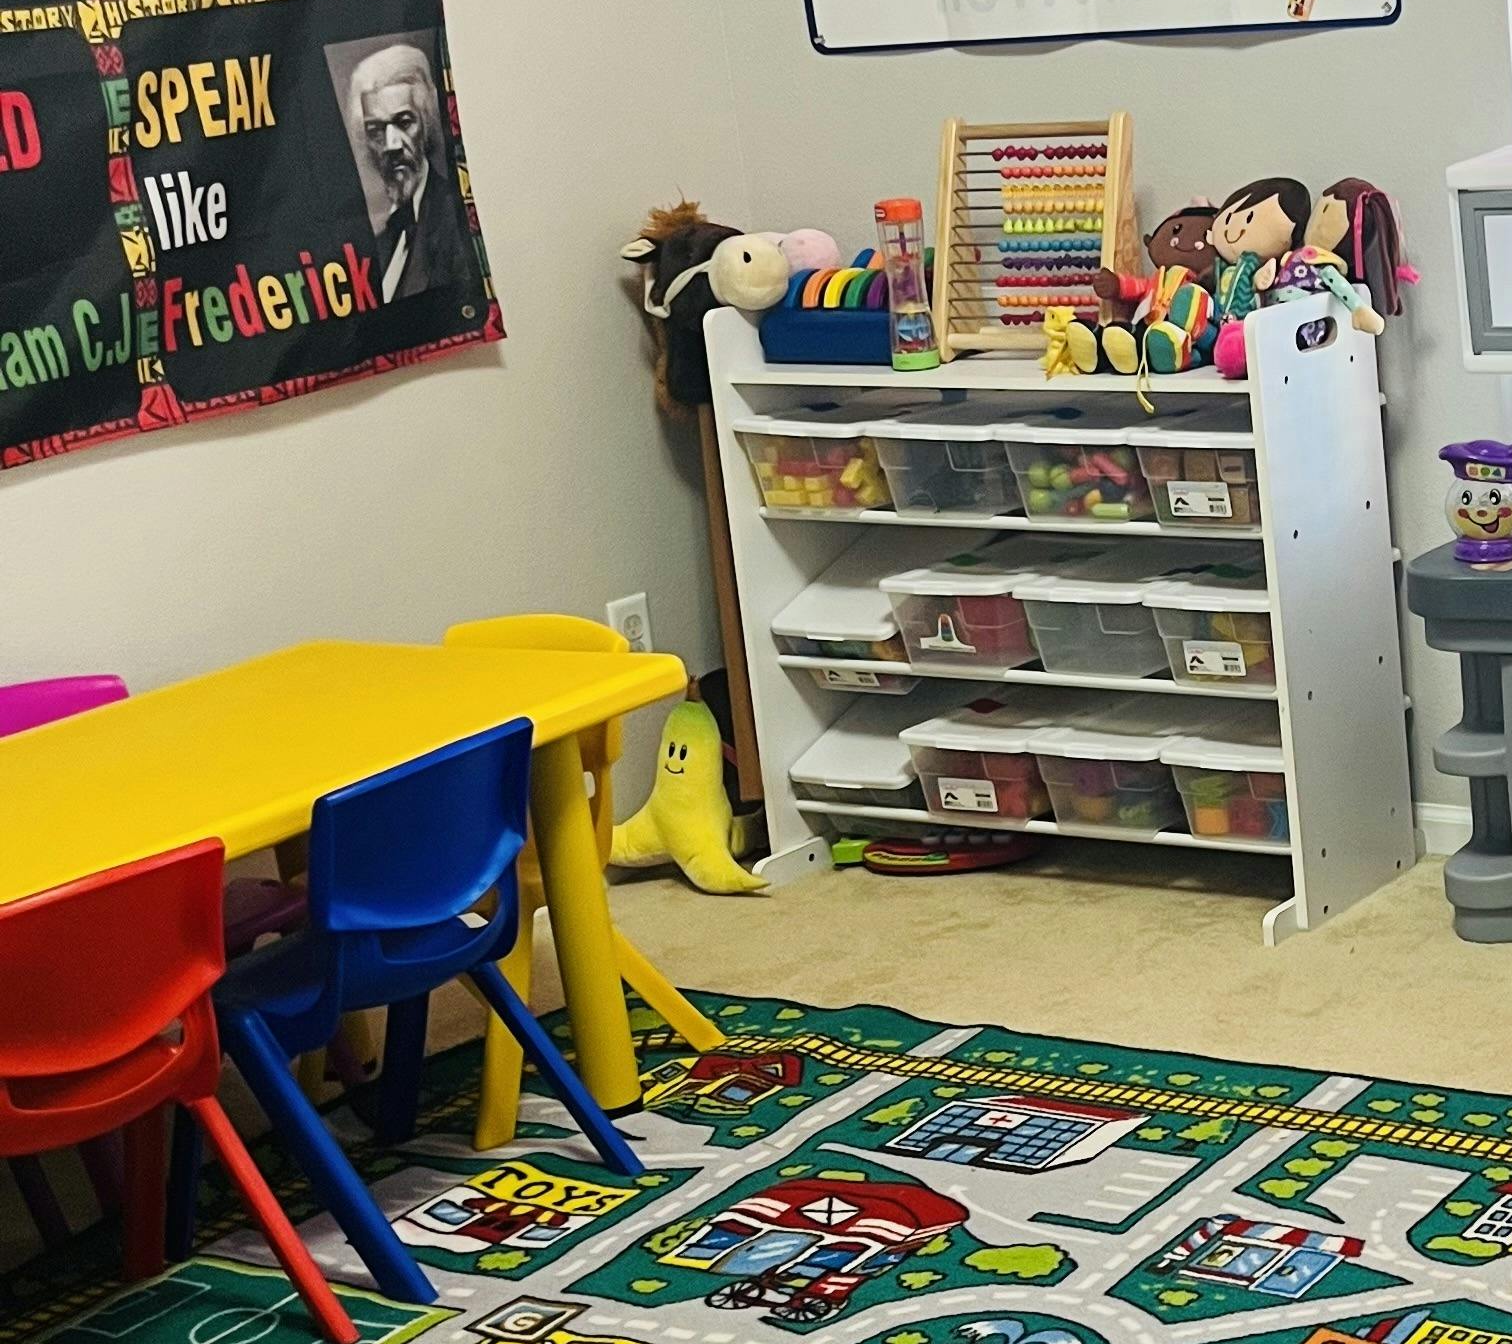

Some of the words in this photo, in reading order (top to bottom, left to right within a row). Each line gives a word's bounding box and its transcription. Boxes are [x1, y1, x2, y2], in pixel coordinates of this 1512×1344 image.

[134, 55, 277, 150] SPEAK
[144, 174, 228, 253] like
[163, 242, 380, 354] Frederick
[479, 1165, 612, 1212] TOYS
